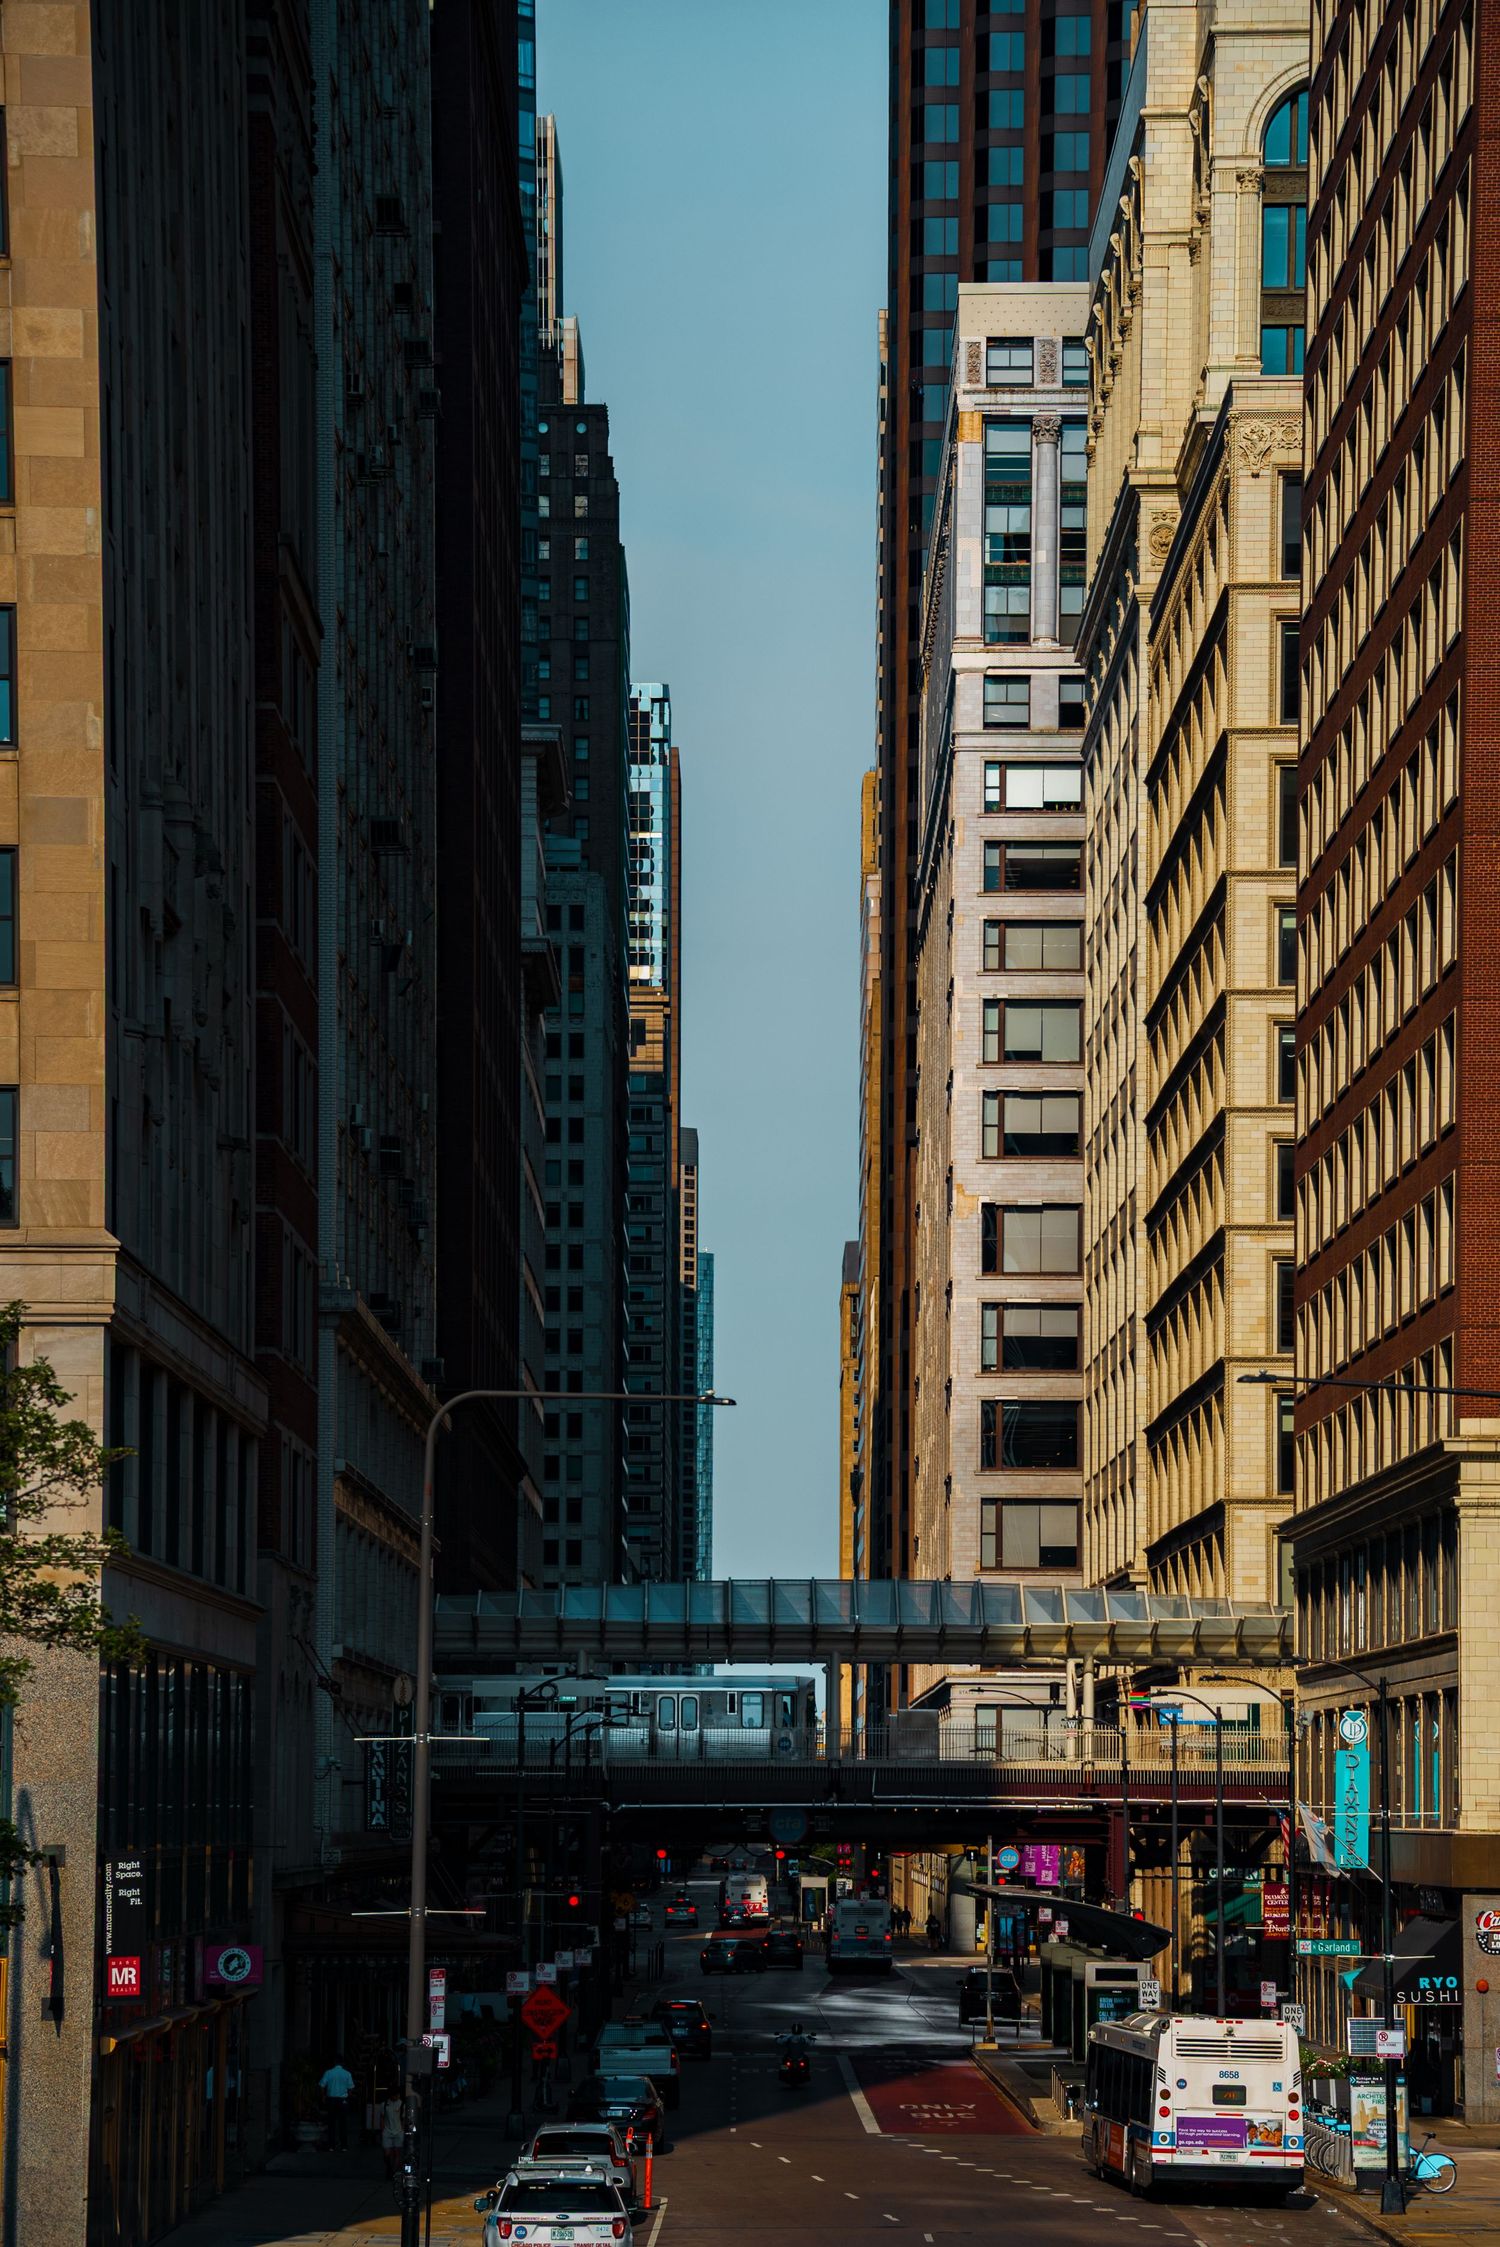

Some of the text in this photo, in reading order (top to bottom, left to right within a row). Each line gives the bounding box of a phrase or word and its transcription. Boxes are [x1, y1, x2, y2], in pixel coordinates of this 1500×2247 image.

[371, 1740, 386, 1826] CANTINA
[1345, 1754, 1361, 1856] DIAMONDS
[776, 1814, 801, 1831] cta
[1001, 1854, 1017, 1862] cta
[118, 1861, 141, 1870] Right
[115, 1871, 143, 1880] Space.
[118, 1888, 141, 1897] Right
[130, 1898, 143, 1906] Fit.
[104, 1862, 113, 1955] www.marcrealty.com
[1317, 1942, 1351, 1952] Garland
[111, 1967, 137, 1985] MR
[1141, 1981, 1158, 1990] ONE
[1419, 1977, 1458, 1989] RYO
[1141, 1990, 1158, 1998] WAY
[1396, 1990, 1459, 2003] SUSHI
[1284, 2006, 1302, 2015] ONE
[1283, 2015, 1303, 2023] WAY
[1218, 2070, 1240, 2079] 8658
